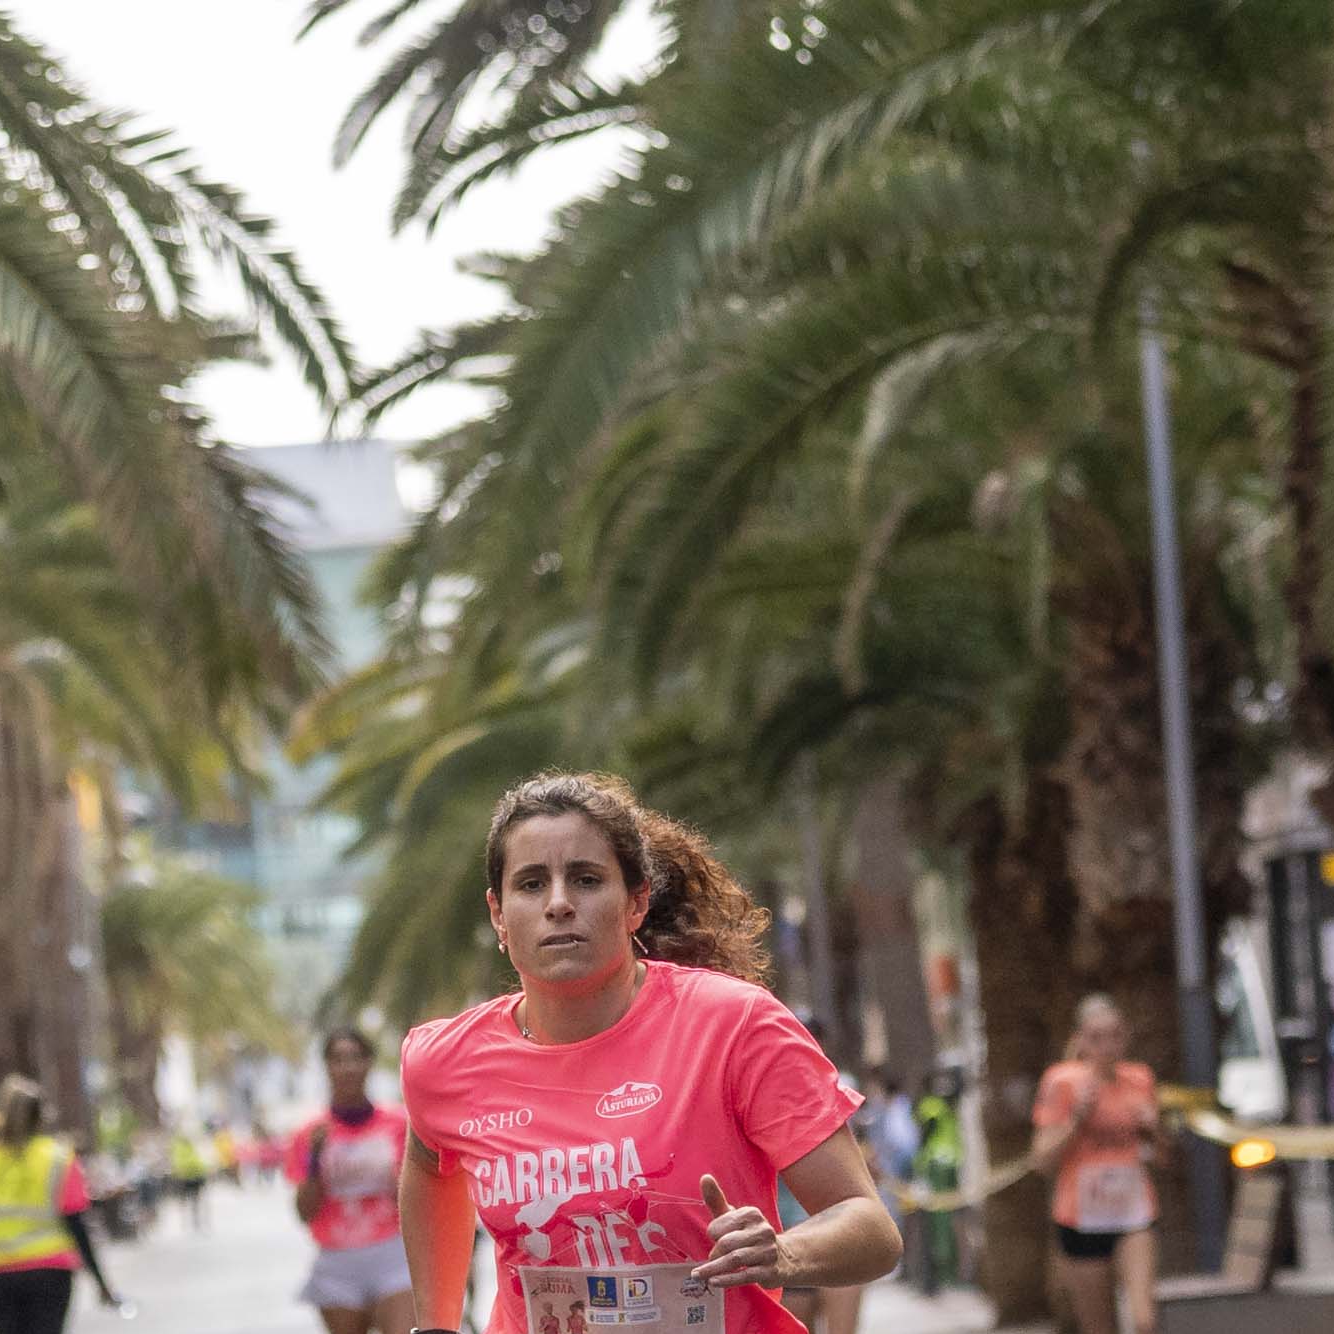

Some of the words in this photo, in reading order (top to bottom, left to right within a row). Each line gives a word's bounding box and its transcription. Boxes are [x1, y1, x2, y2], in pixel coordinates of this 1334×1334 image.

[601, 1092, 657, 1114] ASTURIANA
[458, 1108, 533, 1137] OYSHO
[473, 1136, 648, 1208] CARRERA
